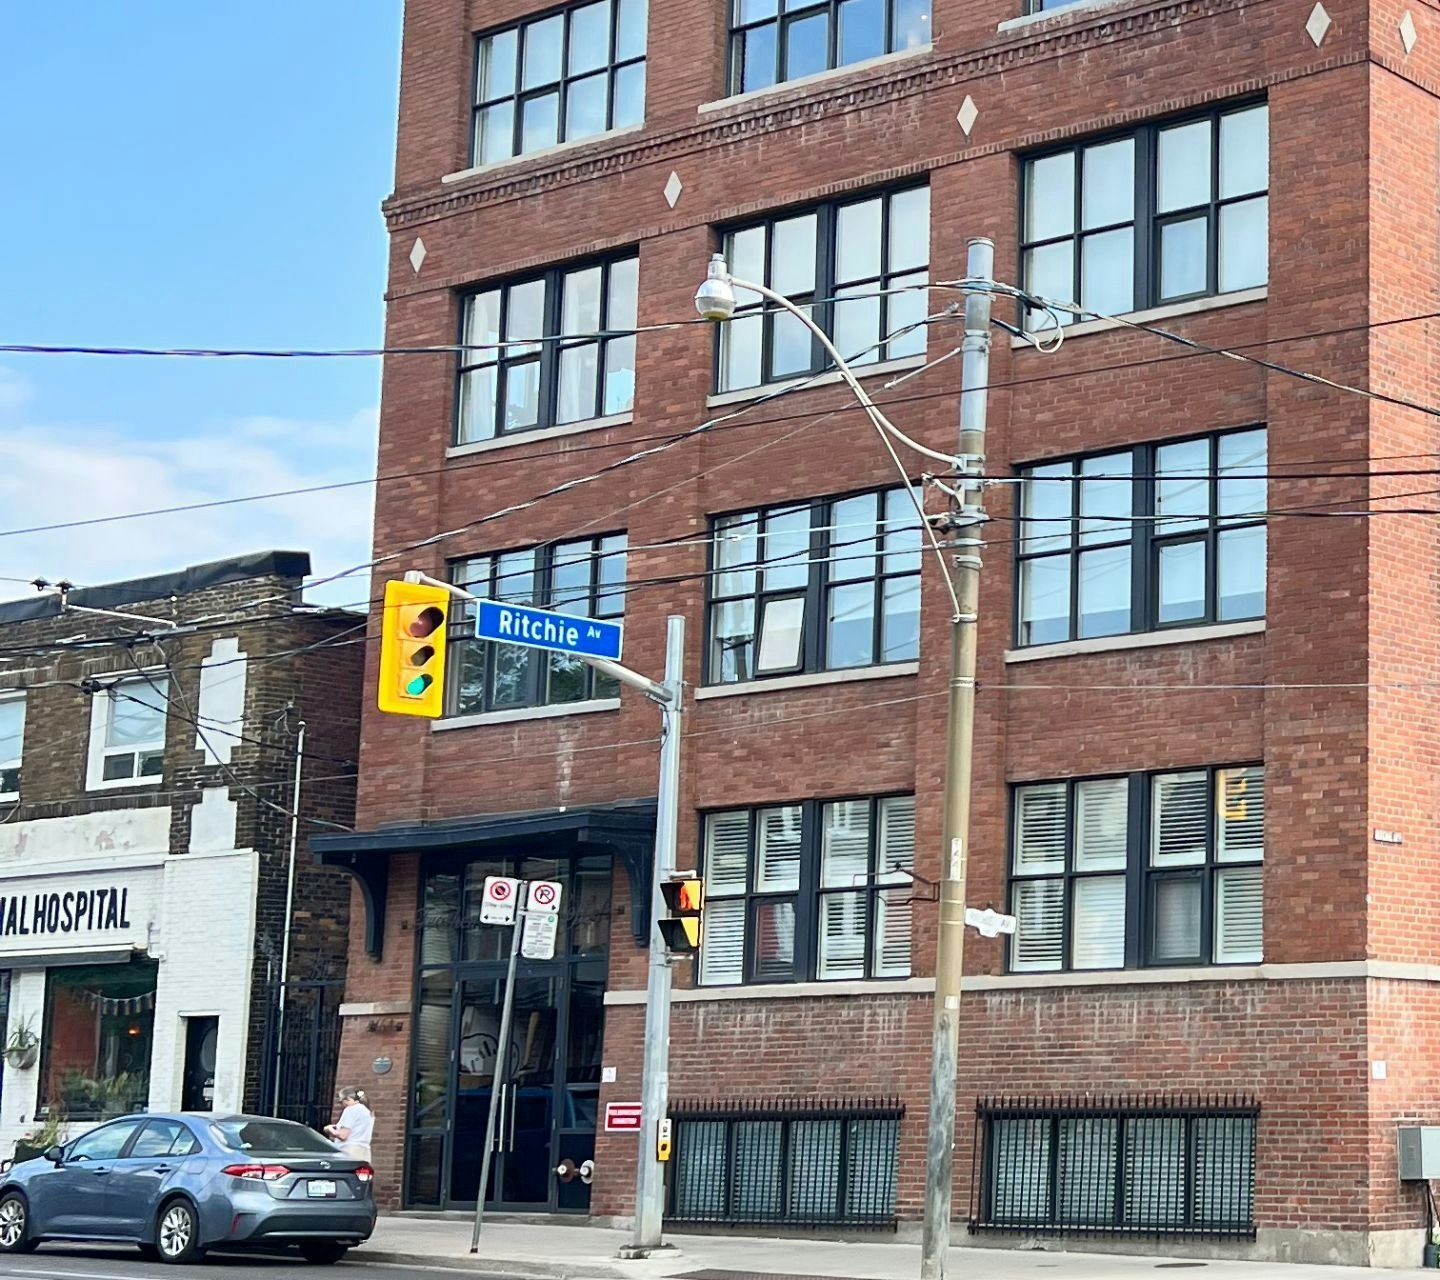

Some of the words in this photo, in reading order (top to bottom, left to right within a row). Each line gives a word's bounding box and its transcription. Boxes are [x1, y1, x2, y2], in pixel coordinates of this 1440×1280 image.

[498, 609, 579, 646] Ritchie
[586, 625, 602, 639] Av
[32, 887, 131, 934] HOSPITAL
